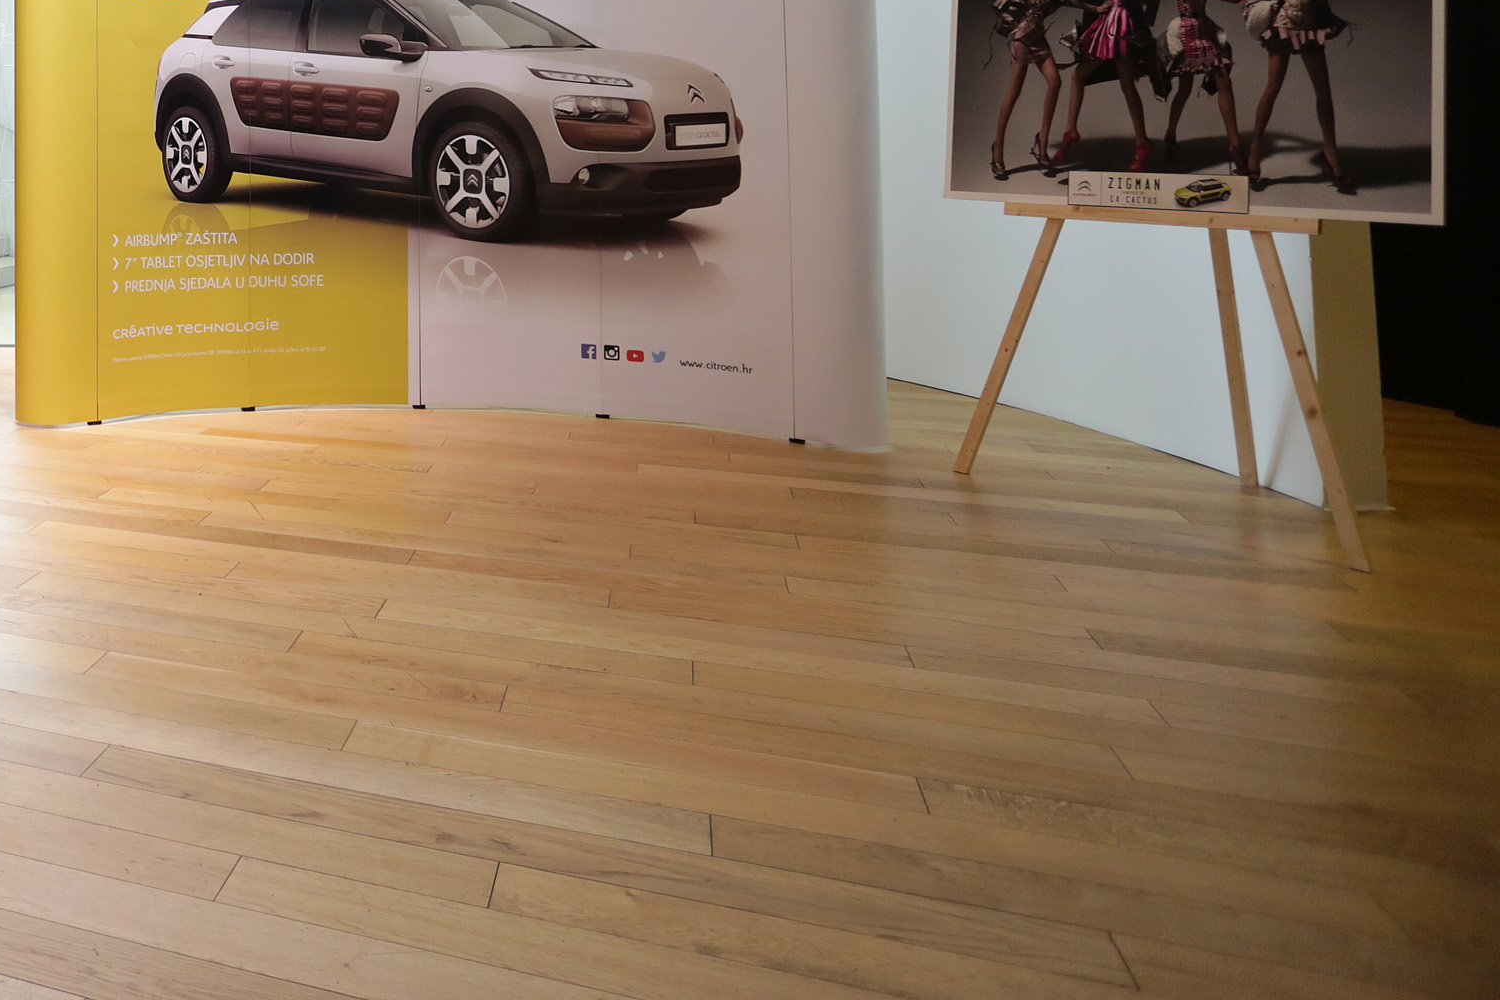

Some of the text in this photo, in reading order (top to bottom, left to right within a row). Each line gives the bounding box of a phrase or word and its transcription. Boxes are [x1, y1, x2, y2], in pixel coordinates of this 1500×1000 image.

[1108, 177, 1160, 191] ZIGMAN
[1110, 195, 1119, 203] C4
[1126, 196, 1157, 205] CACTUS
[185, 230, 238, 245] ZAŠTITA
[140, 255, 183, 269] TABLET
[185, 254, 246, 269] OSJETLJIV
[250, 253, 270, 266] NA
[273, 253, 315, 266] DODIR
[125, 274, 324, 293] PREDNJA SJEDALA U DUHU SOFE
[679, 359, 753, 374] www.citroen.hr
